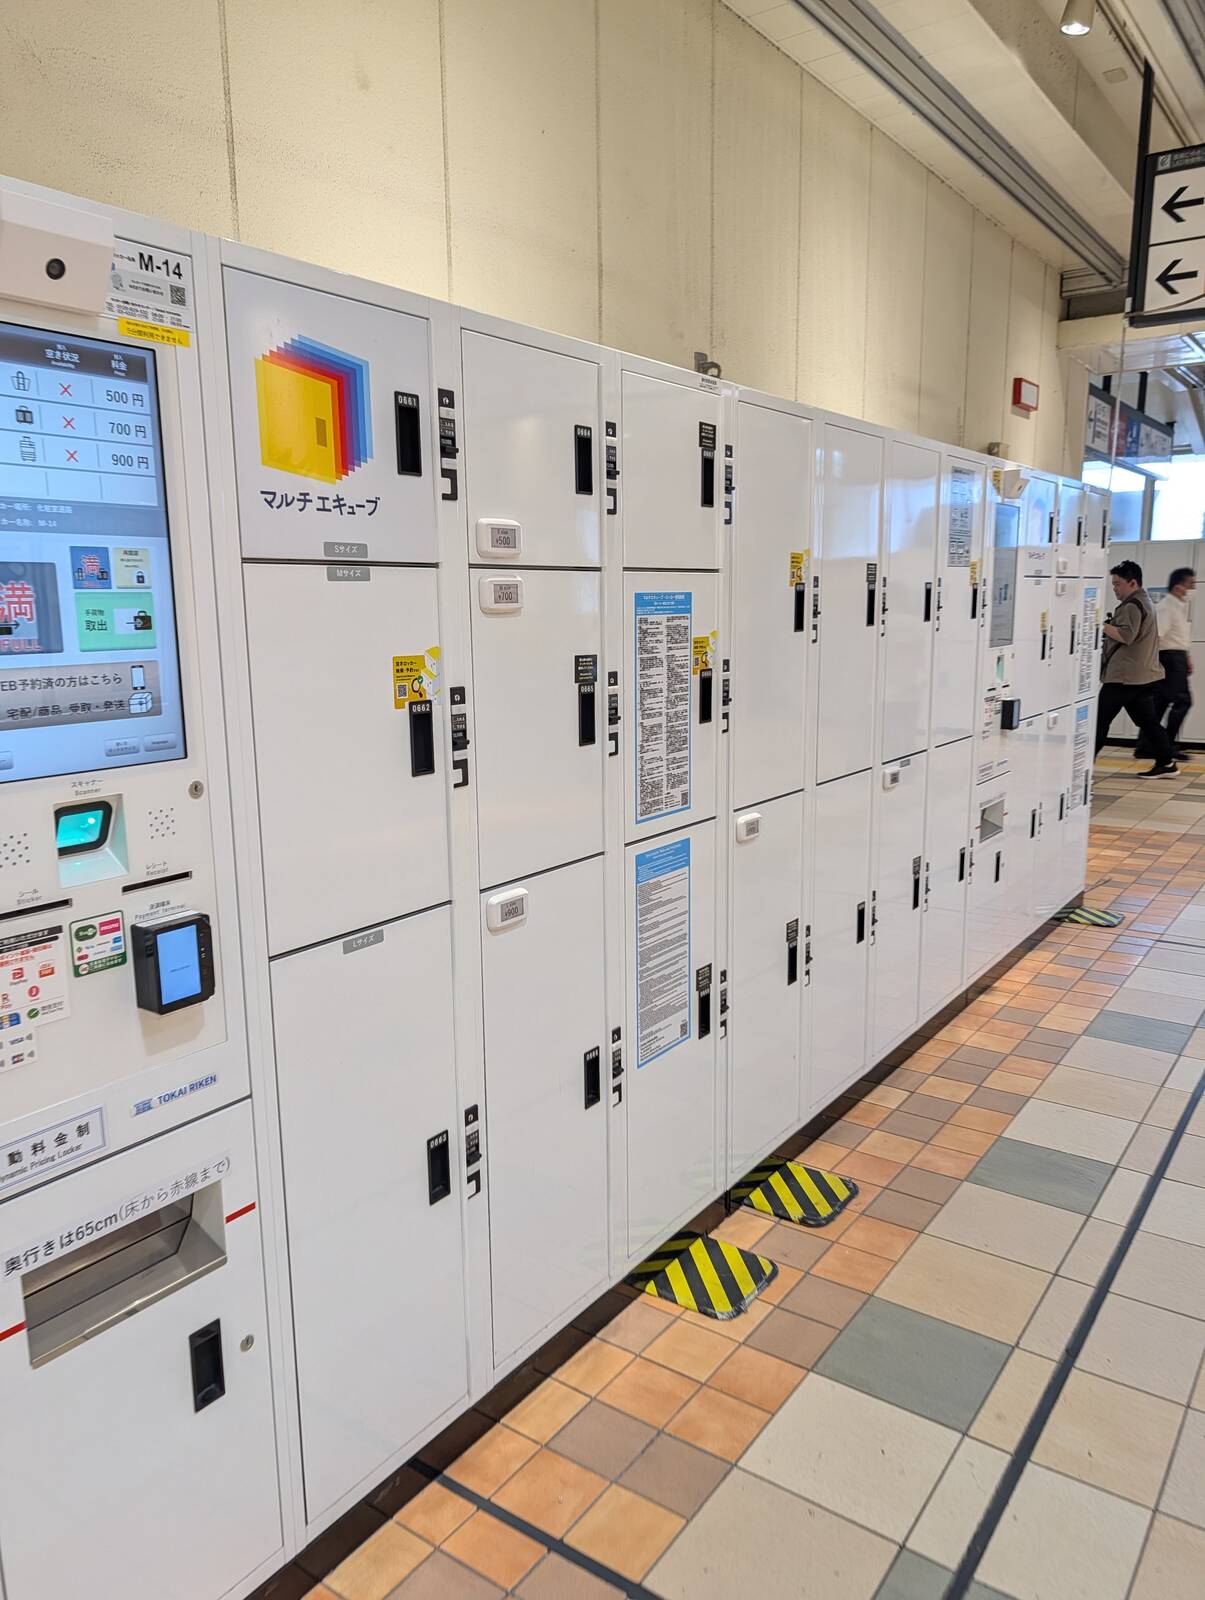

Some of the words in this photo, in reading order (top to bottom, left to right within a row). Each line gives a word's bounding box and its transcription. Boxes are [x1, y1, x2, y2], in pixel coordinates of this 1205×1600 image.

[138, 252, 184, 281] M-14
[45, 348, 81, 364] 空き状況
[105, 389, 129, 405] 500
[132, 393, 145, 408] 円
[108, 421, 131, 437] 700
[134, 425, 148, 439] 円
[111, 453, 136, 469] 900
[137, 455, 150, 470] 円
[259, 490, 381, 517] マルチエキューブ
[333, 544, 359, 554] Sサイズ
[336, 568, 362, 578] Mサイズ
[84, 619, 108, 633] 取出
[412, 703, 432, 713] 0662
[74, 787, 102, 797] Scanner
[352, 934, 377, 949] Lサイズ
[156, 1084, 188, 1105] TOKAI
[189, 1073, 218, 1093] RIKEN
[57, 1141, 83, 1162] Locker
